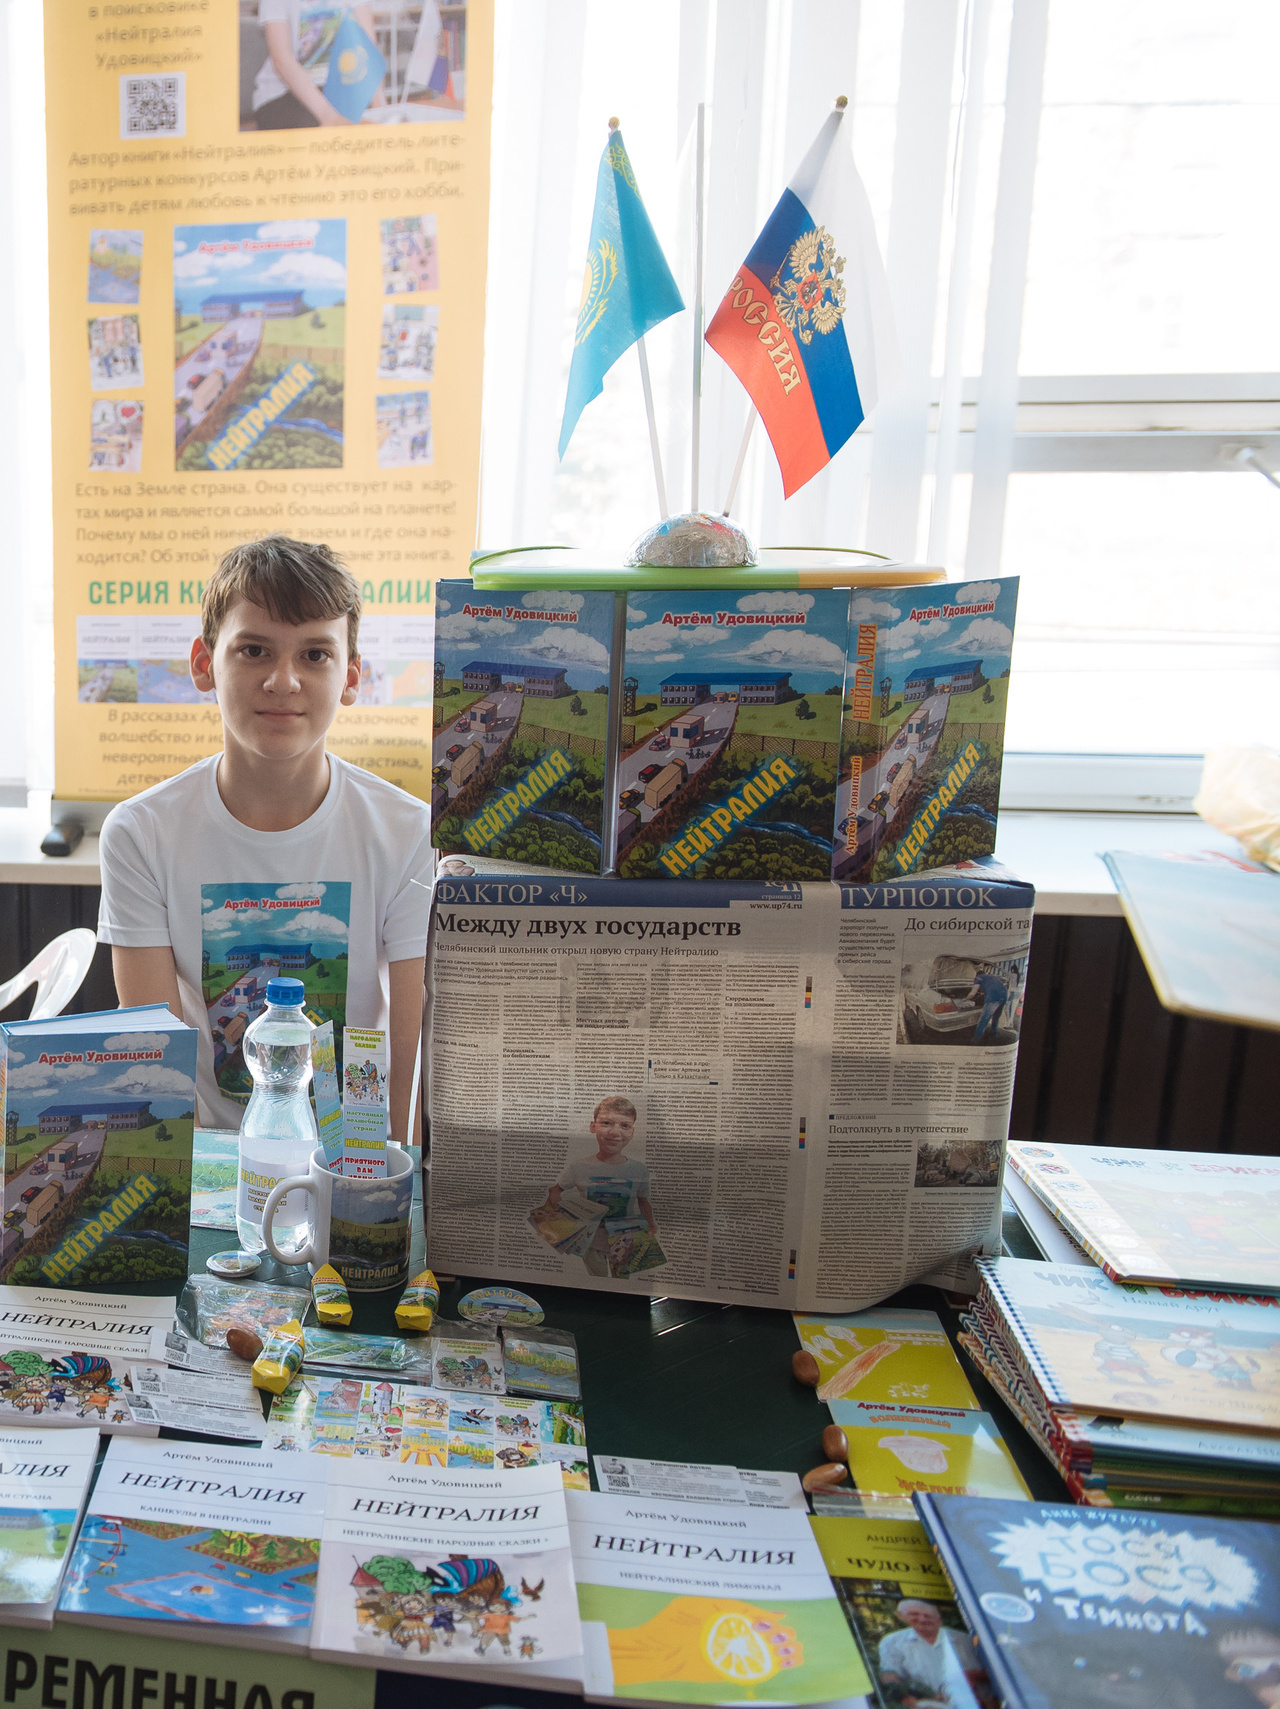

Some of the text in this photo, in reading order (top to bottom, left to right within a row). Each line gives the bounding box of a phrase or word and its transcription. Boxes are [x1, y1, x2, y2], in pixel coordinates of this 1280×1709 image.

[96, 24, 203, 42] «Нейтралия
[95, 50, 203, 69] Удовицкий»
[69, 134, 466, 168] Автор книги «Нейтралия» победитель лите-
[69, 157, 466, 194] ратурных конкурсов Артём Удовицкий. При-
[69, 181, 465, 215] вивать детям любовь к чтению это его хобби.
[199, 237, 312, 253] Артём Удовицкий
[725, 276, 801, 395] РОССИЯ
[208, 361, 315, 470] НЕЙТРАЛИЯ
[76, 480, 457, 498] Есть на Земле страна. Она существует на кар-
[77, 501, 457, 521] тах мира и является самой большой на планете!
[76, 526, 457, 545] Почему мы о ней знаем и где она на-
[76, 547, 210, 566] ходится? Об этой
[377, 549, 454, 561] эта книга.
[89, 580, 169, 605] СЕРИЯ
[462, 604, 579, 623] Артём Удовицкий
[662, 610, 805, 627] Артём Удовицкий
[909, 600, 995, 622] Артём Удовицкий
[853, 623, 877, 721] НЕЙТРАЛИЯ
[108, 708, 118, 722] В
[122, 711, 196, 724] рассказах
[98, 730, 191, 743] волшебство
[195, 735, 204, 743] и
[463, 748, 572, 851] НЕЙТРАЛИЯ
[843, 755, 862, 854] Артём Удовицкий
[894, 741, 981, 873] НЕЙТРАЛИЯ
[660, 756, 797, 876] НЕЙТРАЛИЯ
[437, 883, 587, 904] ФАКТОР «Ч»
[842, 887, 996, 907] ТУРПОТОК
[225, 897, 321, 910] Артём Удовицкий
[750, 902, 802, 910] www.up74.ru
[435, 912, 741, 940] Между двух государств
[905, 917, 1012, 933] До сибирской
[434, 943, 718, 958] Челябинский школьник открыл новую страну Нейтралию
[38, 1049, 163, 1066] Артём Удовицкий
[829, 1124, 892, 1136] Подтолкнуть
[904, 1125, 969, 1136] путешествие
[345, 1138, 385, 1150] НЕЙТРАЛИЯ
[345, 1158, 385, 1166] ПРИЯТНОГО
[41, 1173, 160, 1284] НЕЙТРАЛИЯ
[341, 1264, 399, 1279] НЕЙТРАЛИЯ
[1034, 1271, 1110, 1291] ЧИК
[35, 1295, 127, 1310] Артём Удовицкий
[470, 1290, 536, 1307] НЕЙТРАЛИЯ
[0, 1311, 153, 1336] НЕЙТРАЛИЯ
[66, 1340, 111, 1350] НАРОДНЫЕ
[114, 1345, 147, 1353] СКАЗКИ
[857, 1401, 966, 1417] Артём Удовицкий
[870, 1414, 952, 1429] ВОЛШЕБНЫЙ
[163, 1451, 273, 1469] Артём Удовицкий
[119, 1471, 306, 1504] НЕЙТРАЛИЯ
[388, 1475, 503, 1489] Артём Удовицкий
[15, 1492, 52, 1501] СТРАНА
[140, 1504, 197, 1517] КАНИКУЛЫ
[209, 1512, 271, 1525] НЕЙТРАЛИИ
[352, 1497, 541, 1522] НЕЙТРАЛИЯ
[625, 1510, 747, 1529] Артём Удовицкий
[342, 1528, 540, 1547] НЕЙТРАЛИНСКИЕ НАРОДНЫЕ СКАЗКИ
[866, 1534, 921, 1544] АНДРЕЙ
[592, 1534, 796, 1566] НЕЙТРАЛИЯ
[1046, 1534, 1184, 1563] ТОСЯ
[620, 1572, 782, 1591] НЕЙТРАЛИНСКИЙ ЛИМОНАД
[1038, 1550, 1233, 1597] БОСЯ
[1053, 1596, 1210, 1638] ТЕМНОТА
